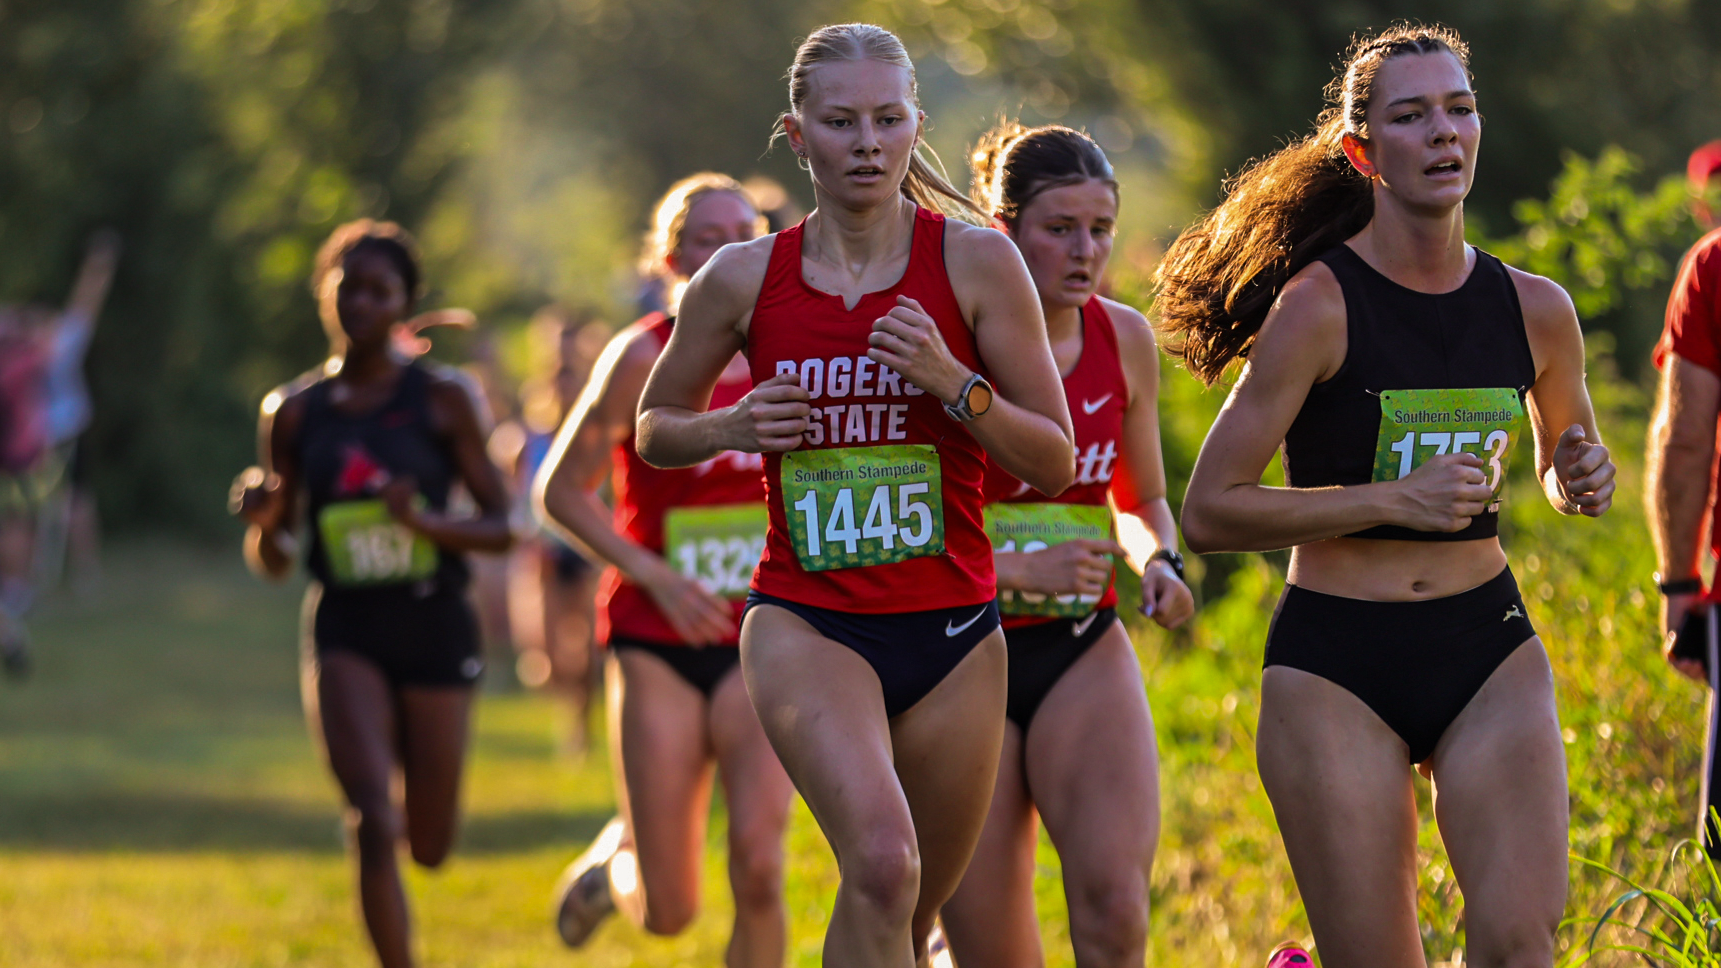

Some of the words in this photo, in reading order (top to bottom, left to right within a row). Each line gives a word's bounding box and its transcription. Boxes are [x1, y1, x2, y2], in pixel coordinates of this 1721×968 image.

[804, 404, 909, 445] STATE
[1395, 409, 1450, 424] Southern
[1454, 408, 1512, 425] Stampede
[794, 468, 854, 483] Southern
[858, 461, 927, 480] Stampede
[794, 482, 934, 556] 1445
[995, 520, 1051, 535] Southern
[1054, 521, 1101, 537] Stampede
